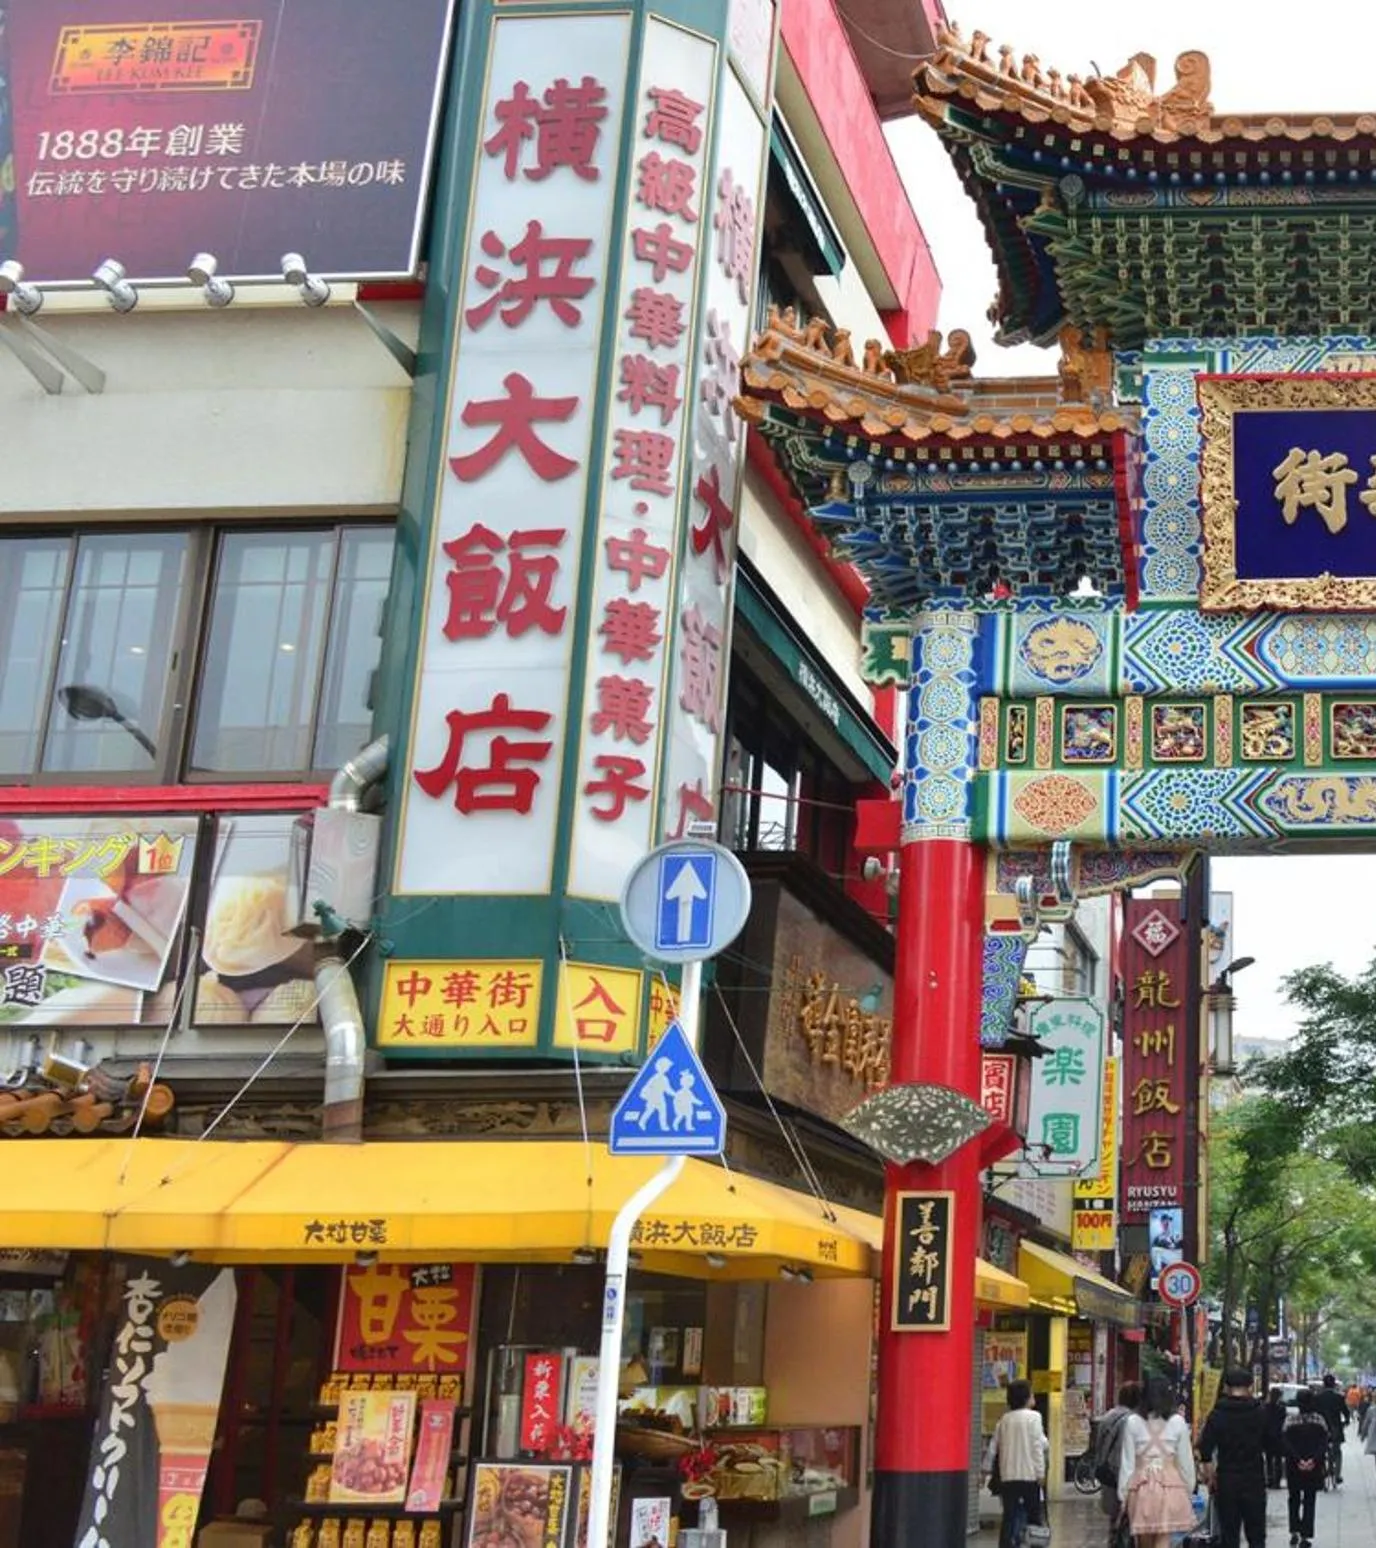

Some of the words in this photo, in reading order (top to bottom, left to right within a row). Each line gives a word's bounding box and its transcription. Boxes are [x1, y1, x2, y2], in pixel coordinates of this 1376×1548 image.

[102, 35, 211, 66] 李錦記
[37, 122, 246, 161] 1888年創業
[26, 159, 406, 198] 伝統を守り続けてきた本場の味
[413, 76, 608, 816] 横浜大飯店
[396, 970, 534, 1010] 中華街
[572, 976, 627, 1043] 入口
[391, 1013, 529, 1039] 大通り入口
[1128, 969, 1181, 1169] 龍州飯店
[1041, 1046, 1086, 1154] 楽園
[1128, 1186, 1177, 1198] RYUSYU
[1167, 1275, 1193, 1295] 30
